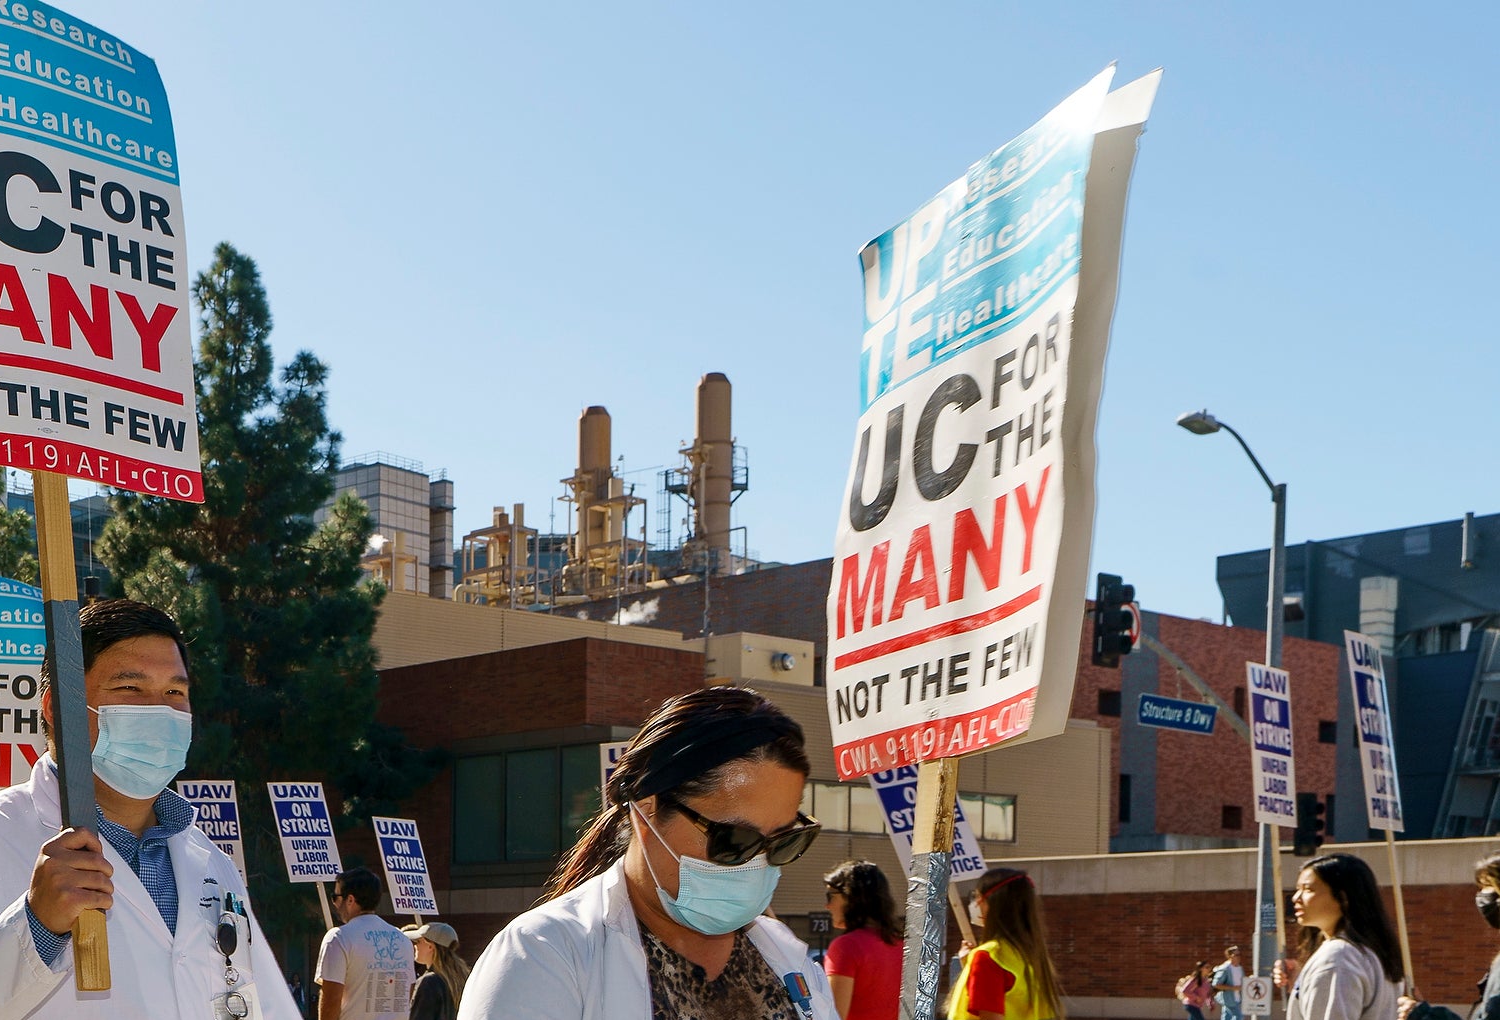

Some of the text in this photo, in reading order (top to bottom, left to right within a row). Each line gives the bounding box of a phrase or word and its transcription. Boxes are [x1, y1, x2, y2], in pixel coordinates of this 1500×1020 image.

[69, 168, 175, 238] FOR
[70, 222, 176, 291] THE
[862, 200, 949, 325] UP
[936, 232, 1077, 344] Healthcare
[861, 280, 937, 405] TE
[990, 311, 1062, 412] FOR
[103, 401, 187, 452] FEW
[985, 384, 1055, 479] THE
[849, 372, 984, 532] UC
[835, 465, 1051, 641] MANY
[835, 623, 1036, 725] NOT THE FEW
[1251, 667, 1287, 695] UAW
[1141, 701, 1183, 722] Structure
[1192, 709, 1213, 730] Dwy
[1263, 698, 1280, 722] ON
[1254, 723, 1292, 751] STRIKE
[839, 745, 883, 778] CWA
[182, 784, 232, 799] UAW
[273, 784, 320, 799] UAW
[201, 804, 221, 819] ON
[291, 803, 312, 818] ON
[196, 820, 238, 837] TRIKE
[281, 818, 330, 835] STRIKE
[376, 821, 416, 838] UAW
[291, 839, 329, 851] UNFAIR
[393, 841, 411, 855] ON
[296, 852, 330, 863] LABOR
[386, 855, 427, 872] STRIKE
[291, 863, 340, 876] PRACTICE
[394, 874, 425, 886] UNFAIR
[399, 887, 427, 898] LABOR
[395, 898, 436, 911] PRACTICE
[813, 920, 829, 932] 731
